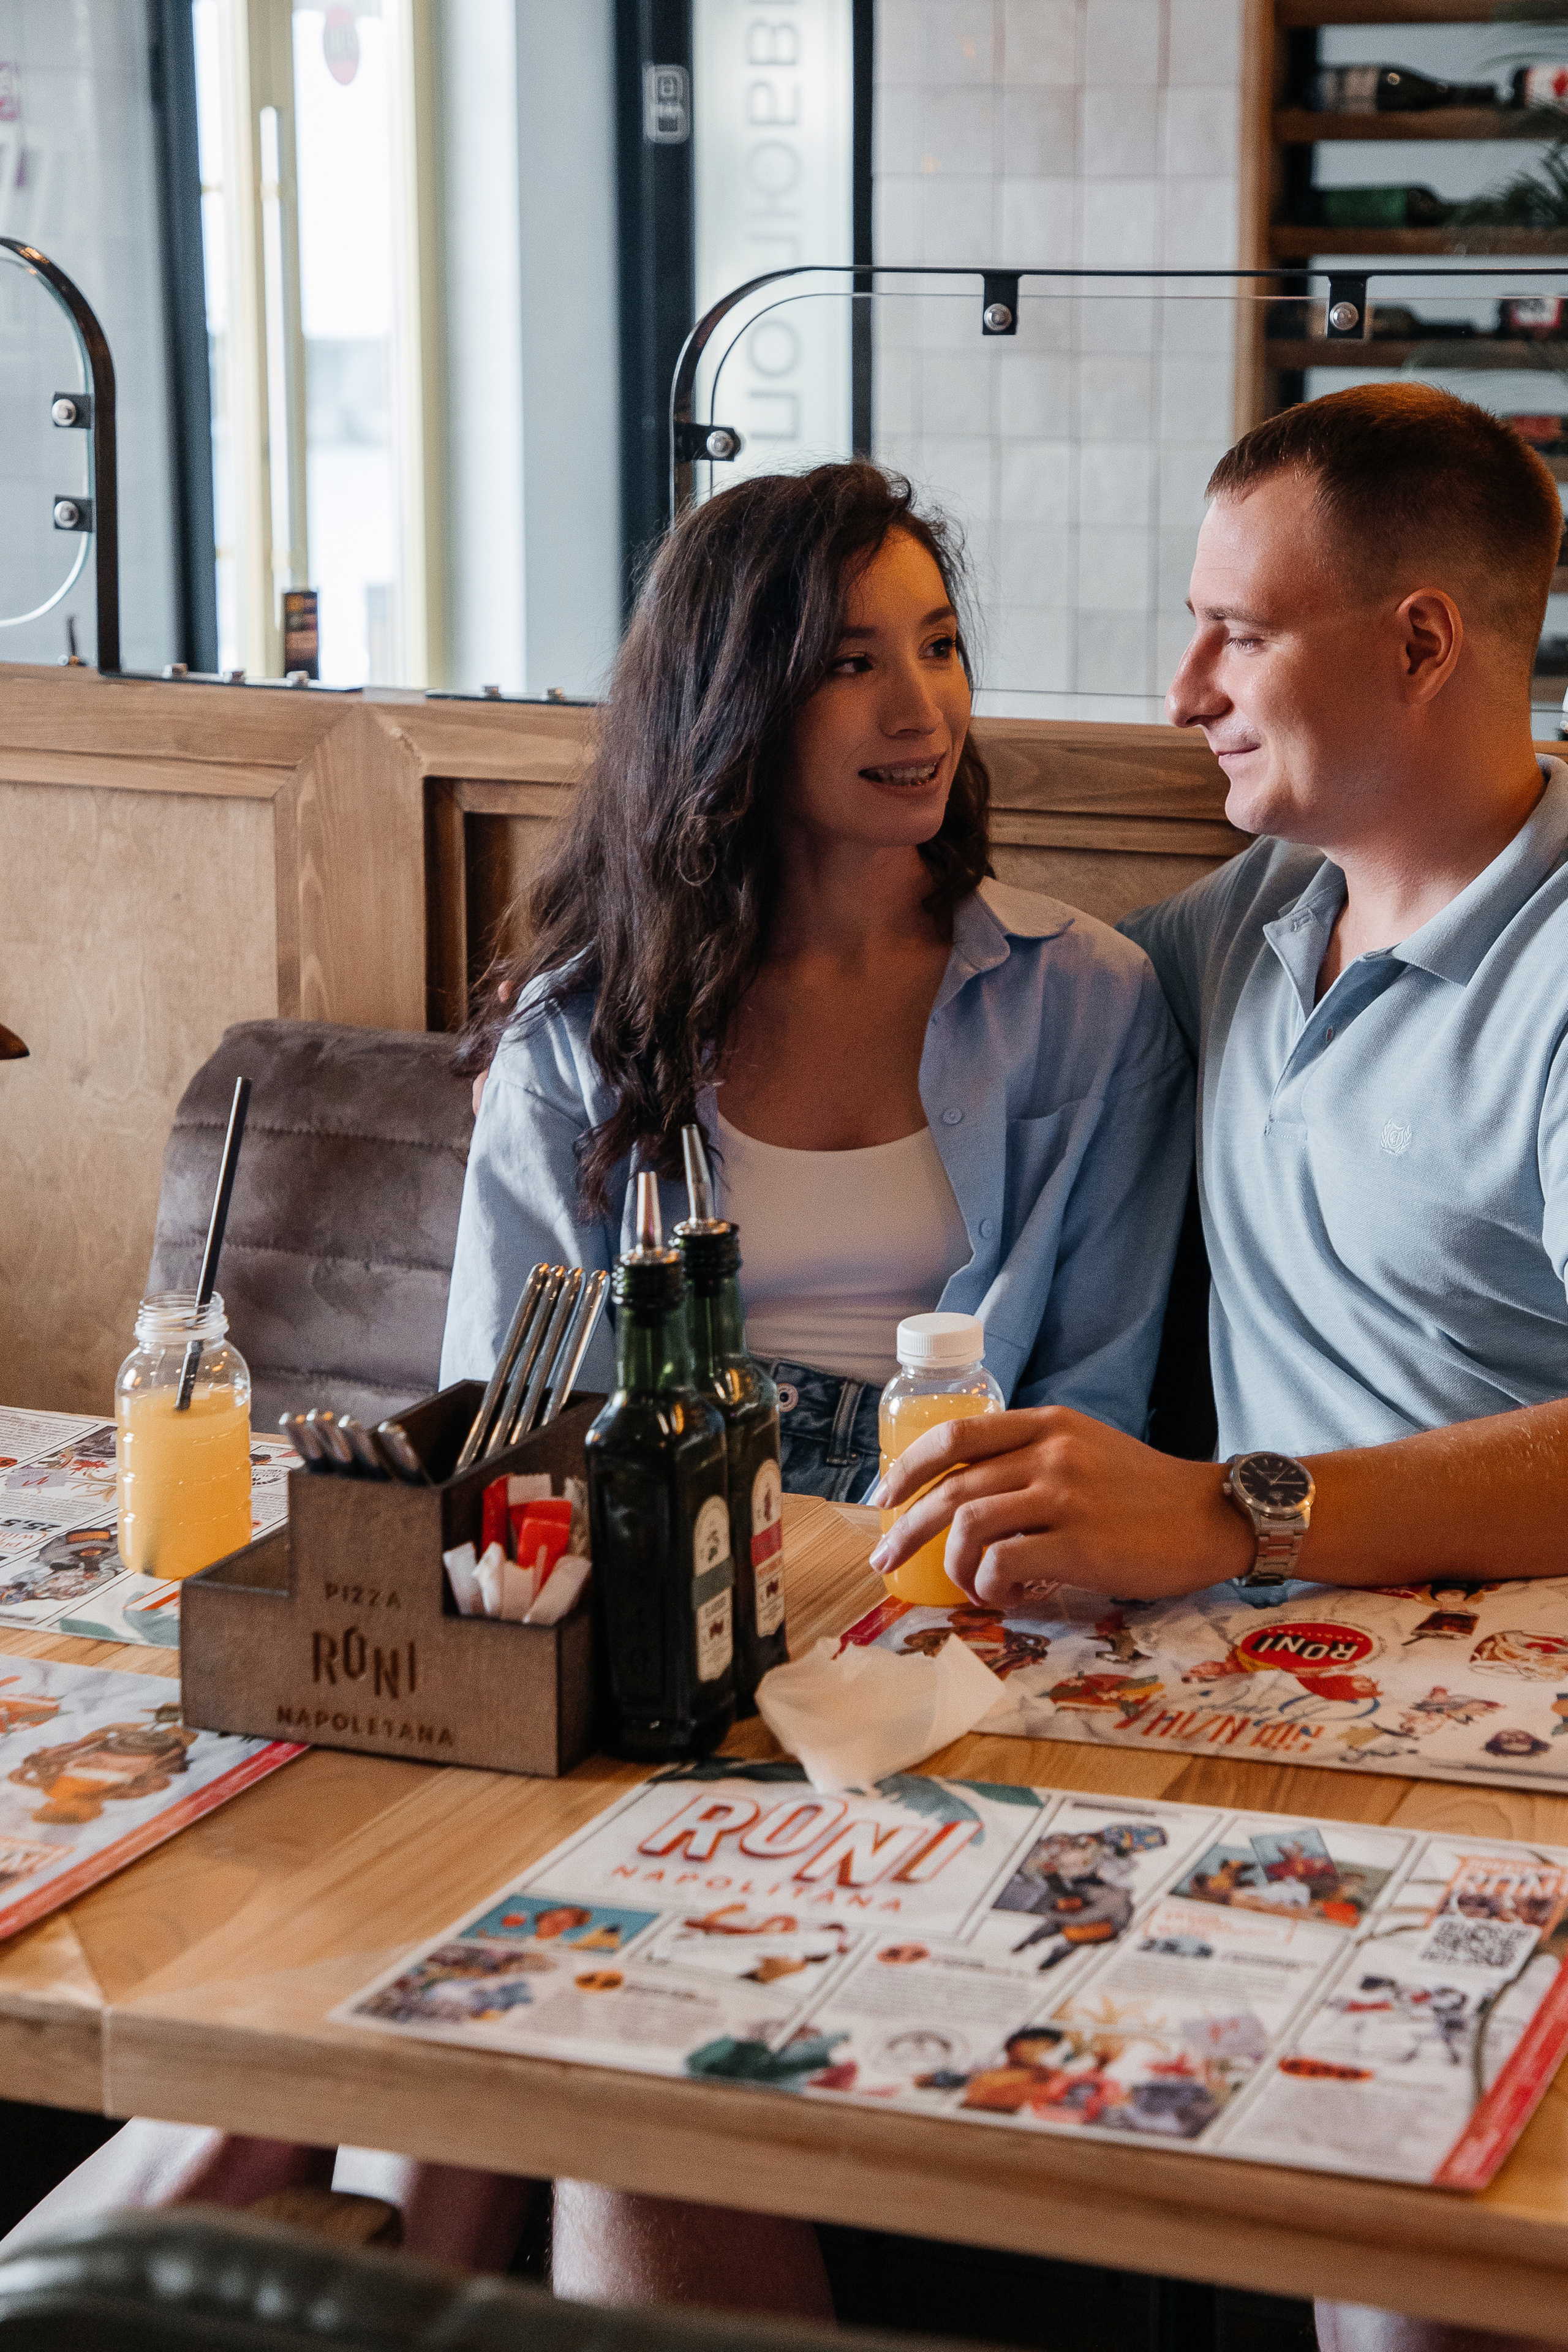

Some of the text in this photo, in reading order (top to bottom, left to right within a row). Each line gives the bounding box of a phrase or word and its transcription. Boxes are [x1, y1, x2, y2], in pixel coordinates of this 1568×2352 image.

[325, 1583, 401, 1610] PIZZA
[312, 1625, 416, 1699] RONI
[1251, 1634, 1359, 1661] RONI
[276, 1705, 454, 1747] NAPOLETANA
[637, 1792, 984, 1888] RONI
[611, 1864, 903, 1913] NAPOLITANA
